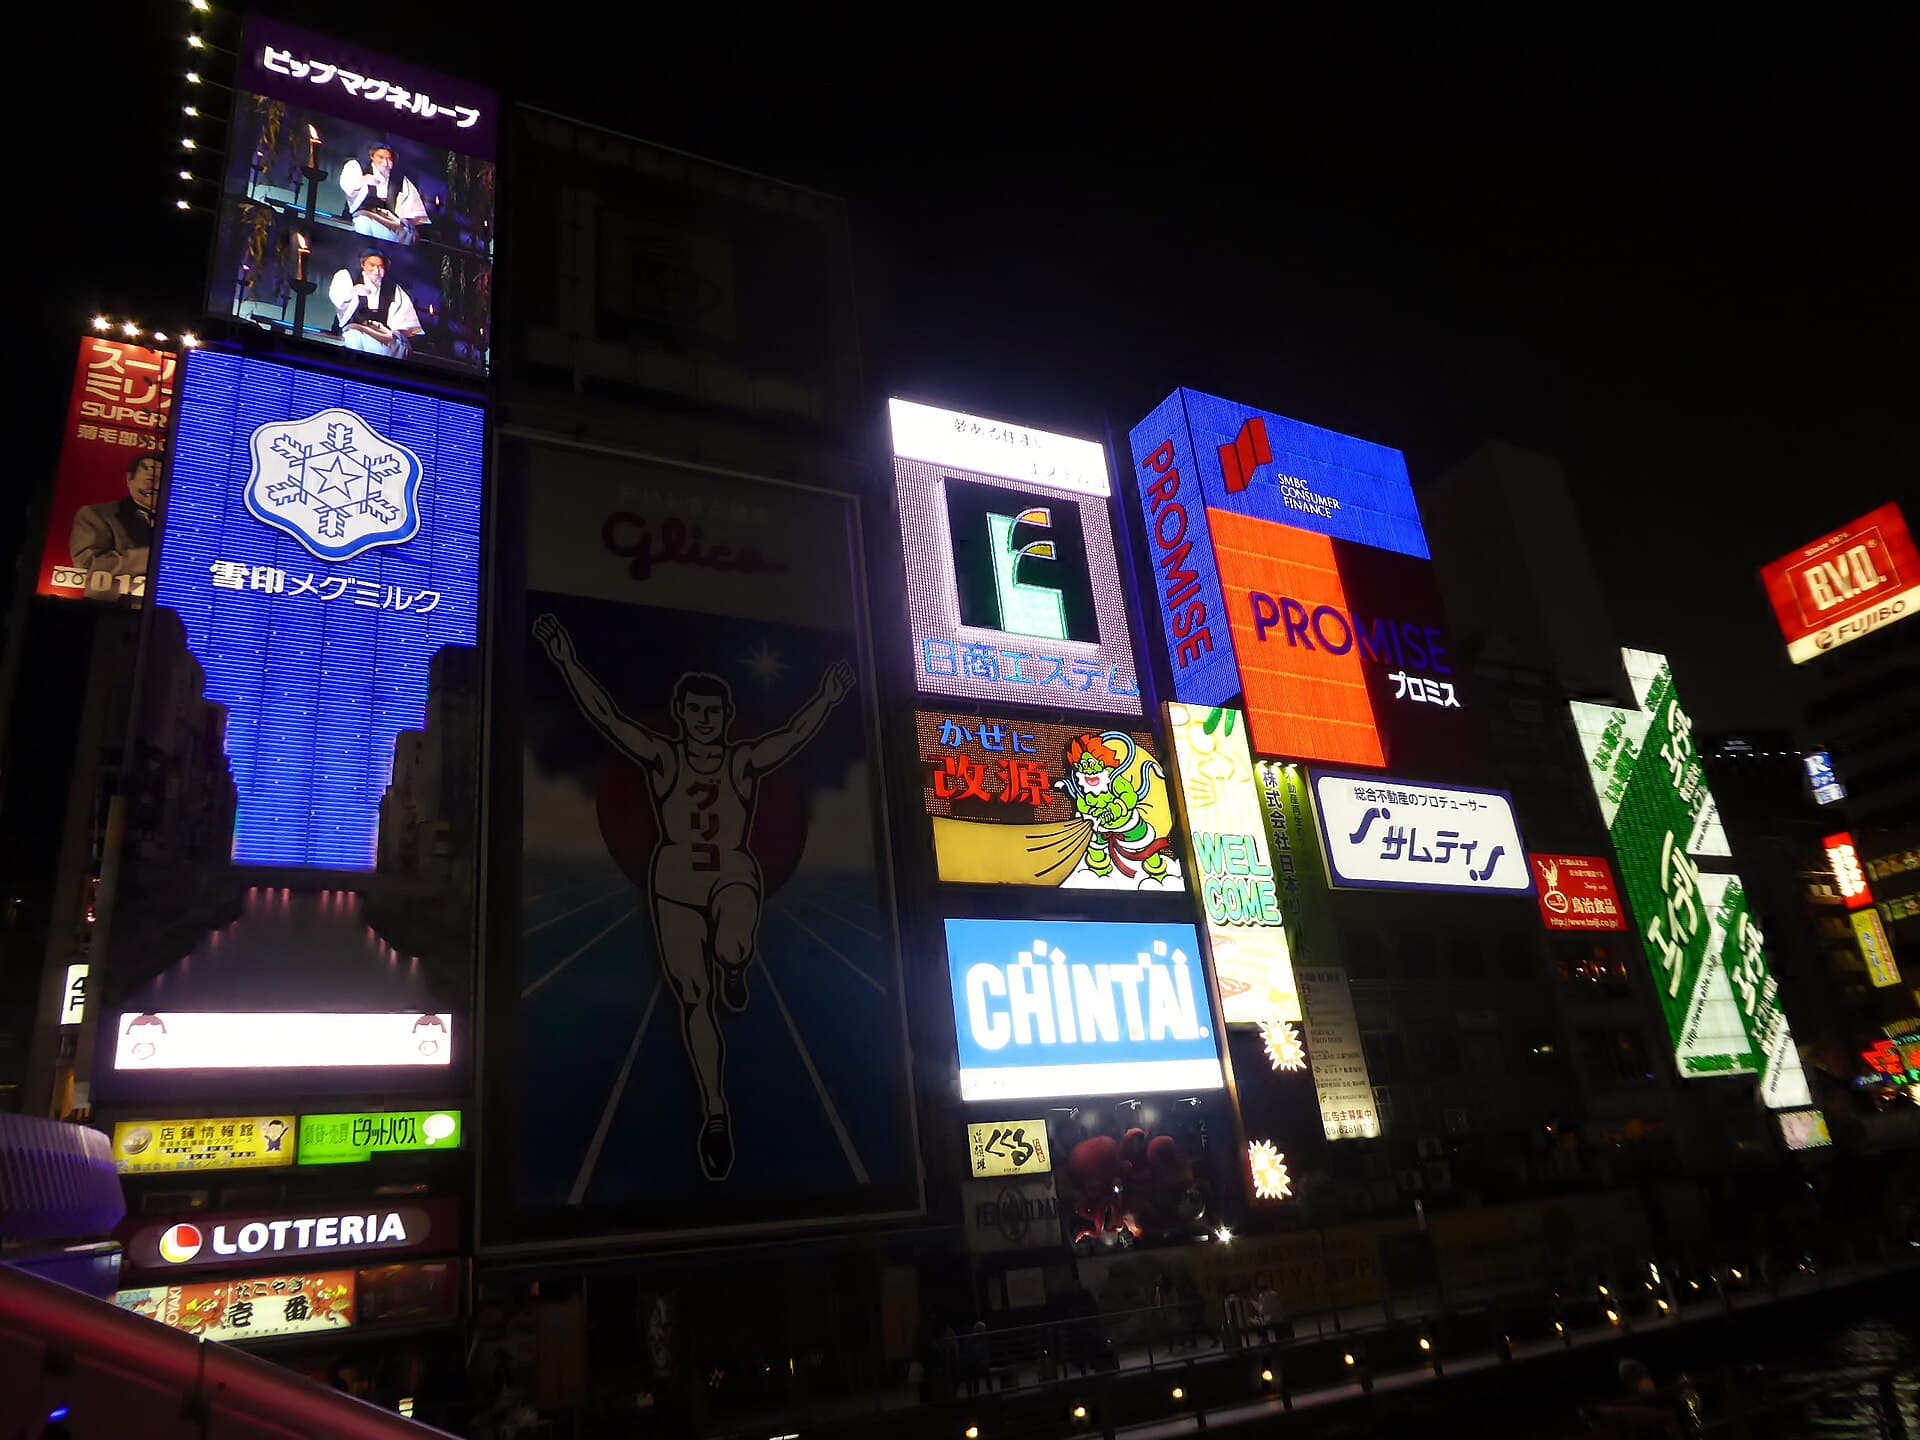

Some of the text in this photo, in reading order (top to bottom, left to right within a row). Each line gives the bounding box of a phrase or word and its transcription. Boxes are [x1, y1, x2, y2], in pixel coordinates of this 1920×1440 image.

[80, 401, 168, 428] SUPER
[1278, 473, 1309, 490] SMBC
[1280, 485, 1341, 509] CONSUMER
[1283, 497, 1332, 518] FINANCE
[601, 511, 790, 581] Glico
[1142, 439, 1213, 669] PROMISE
[209, 560, 442, 613] 雪印メグミルク
[1249, 590, 1453, 674] PROMISE
[1838, 600, 1906, 638] FUJIBO
[923, 638, 1141, 696] 日商エステム
[1388, 671, 1462, 709] プロミス
[938, 719, 1037, 754] かぜに
[1660, 699, 1693, 788] エイブル
[932, 755, 1051, 807] 改源
[1354, 786, 1487, 812] 総合不動産のプロデューサー
[685, 776, 723, 873] グリコ
[1380, 825, 1478, 866] サムティ
[1193, 830, 1274, 878] WEL
[1203, 877, 1283, 927] COME
[1647, 829, 1699, 999] エイブル
[1731, 911, 1765, 1017] エイブル
[352, 1117, 417, 1146] ピタットハウス
[985, 1128, 1034, 1166] くくる
[212, 1213, 407, 1255] LOTTERIA
[164, 1286, 183, 1328] OYAKI
[235, 1276, 305, 1298] たこやき
[227, 1294, 312, 1329] 壱番
